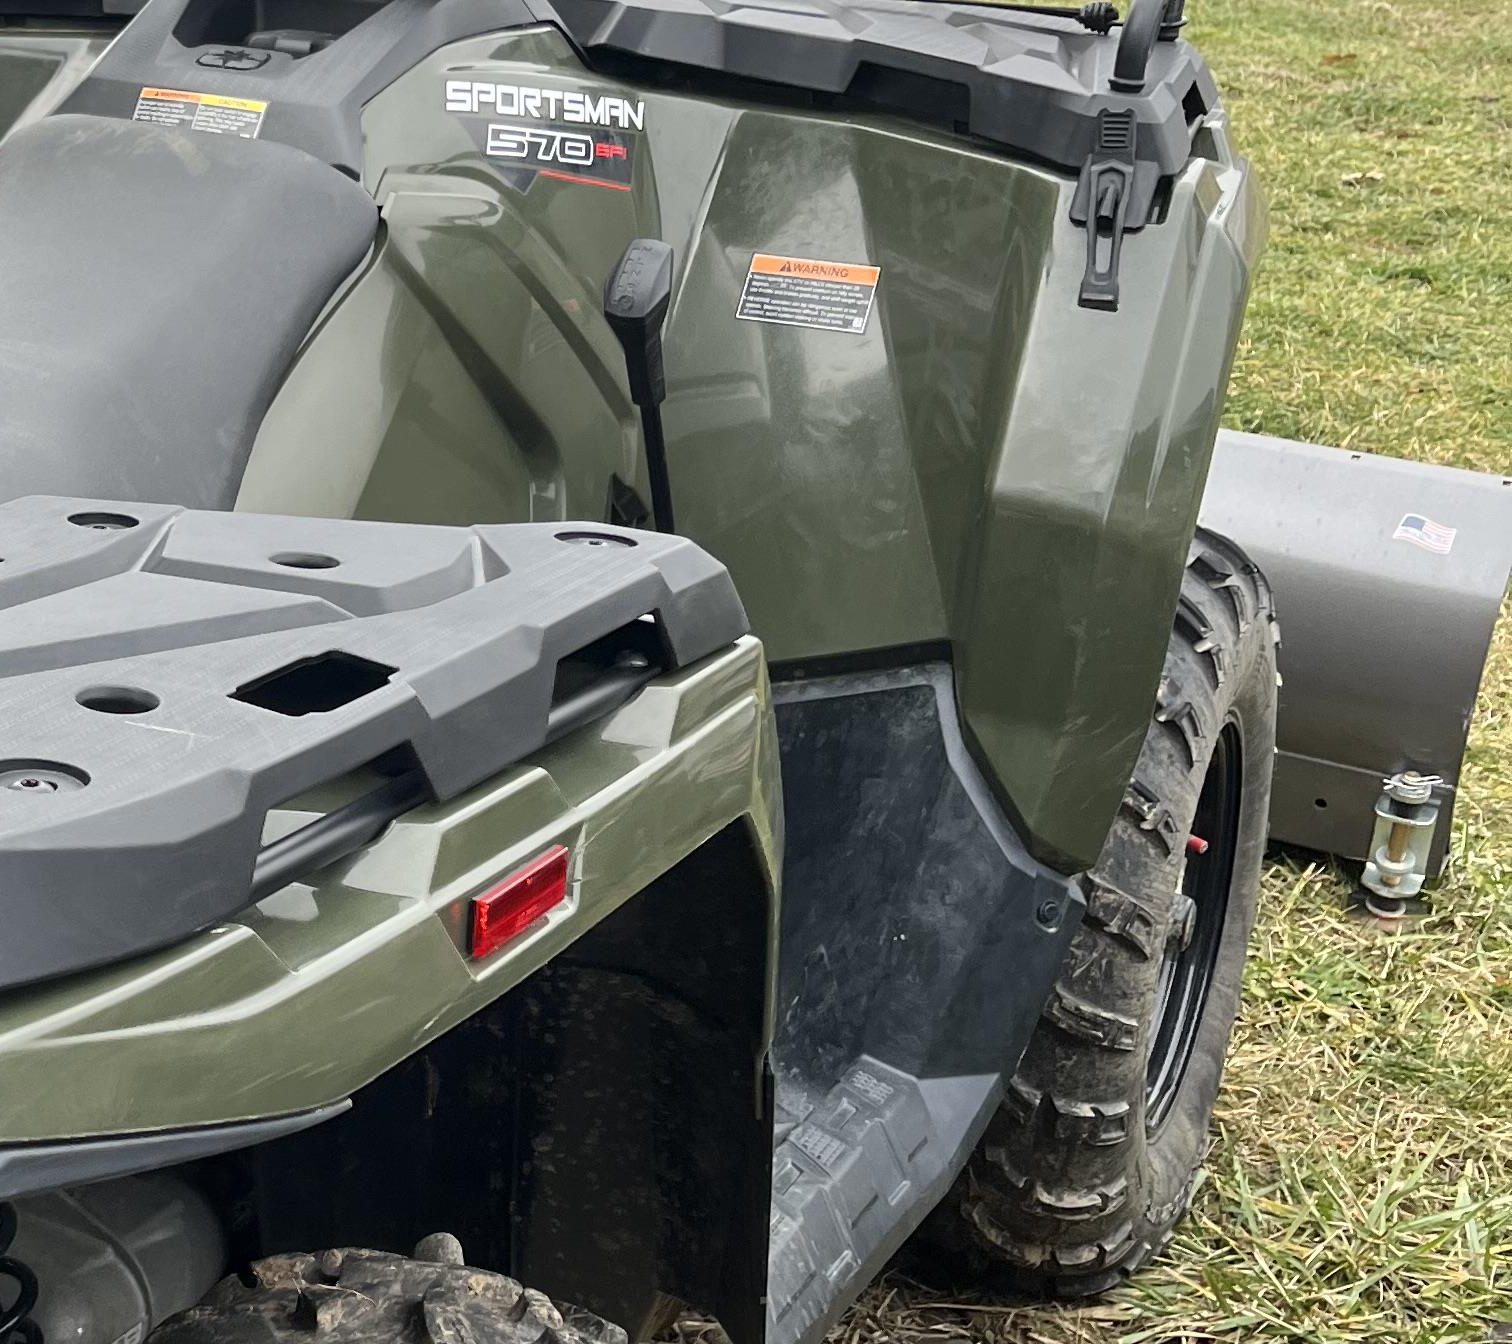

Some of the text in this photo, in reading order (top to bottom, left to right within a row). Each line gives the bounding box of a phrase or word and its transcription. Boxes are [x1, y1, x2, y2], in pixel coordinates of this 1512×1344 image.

[445, 80, 645, 131] SPORTSMAN
[486, 123, 594, 166] 570
[793, 262, 849, 278] WARNING
